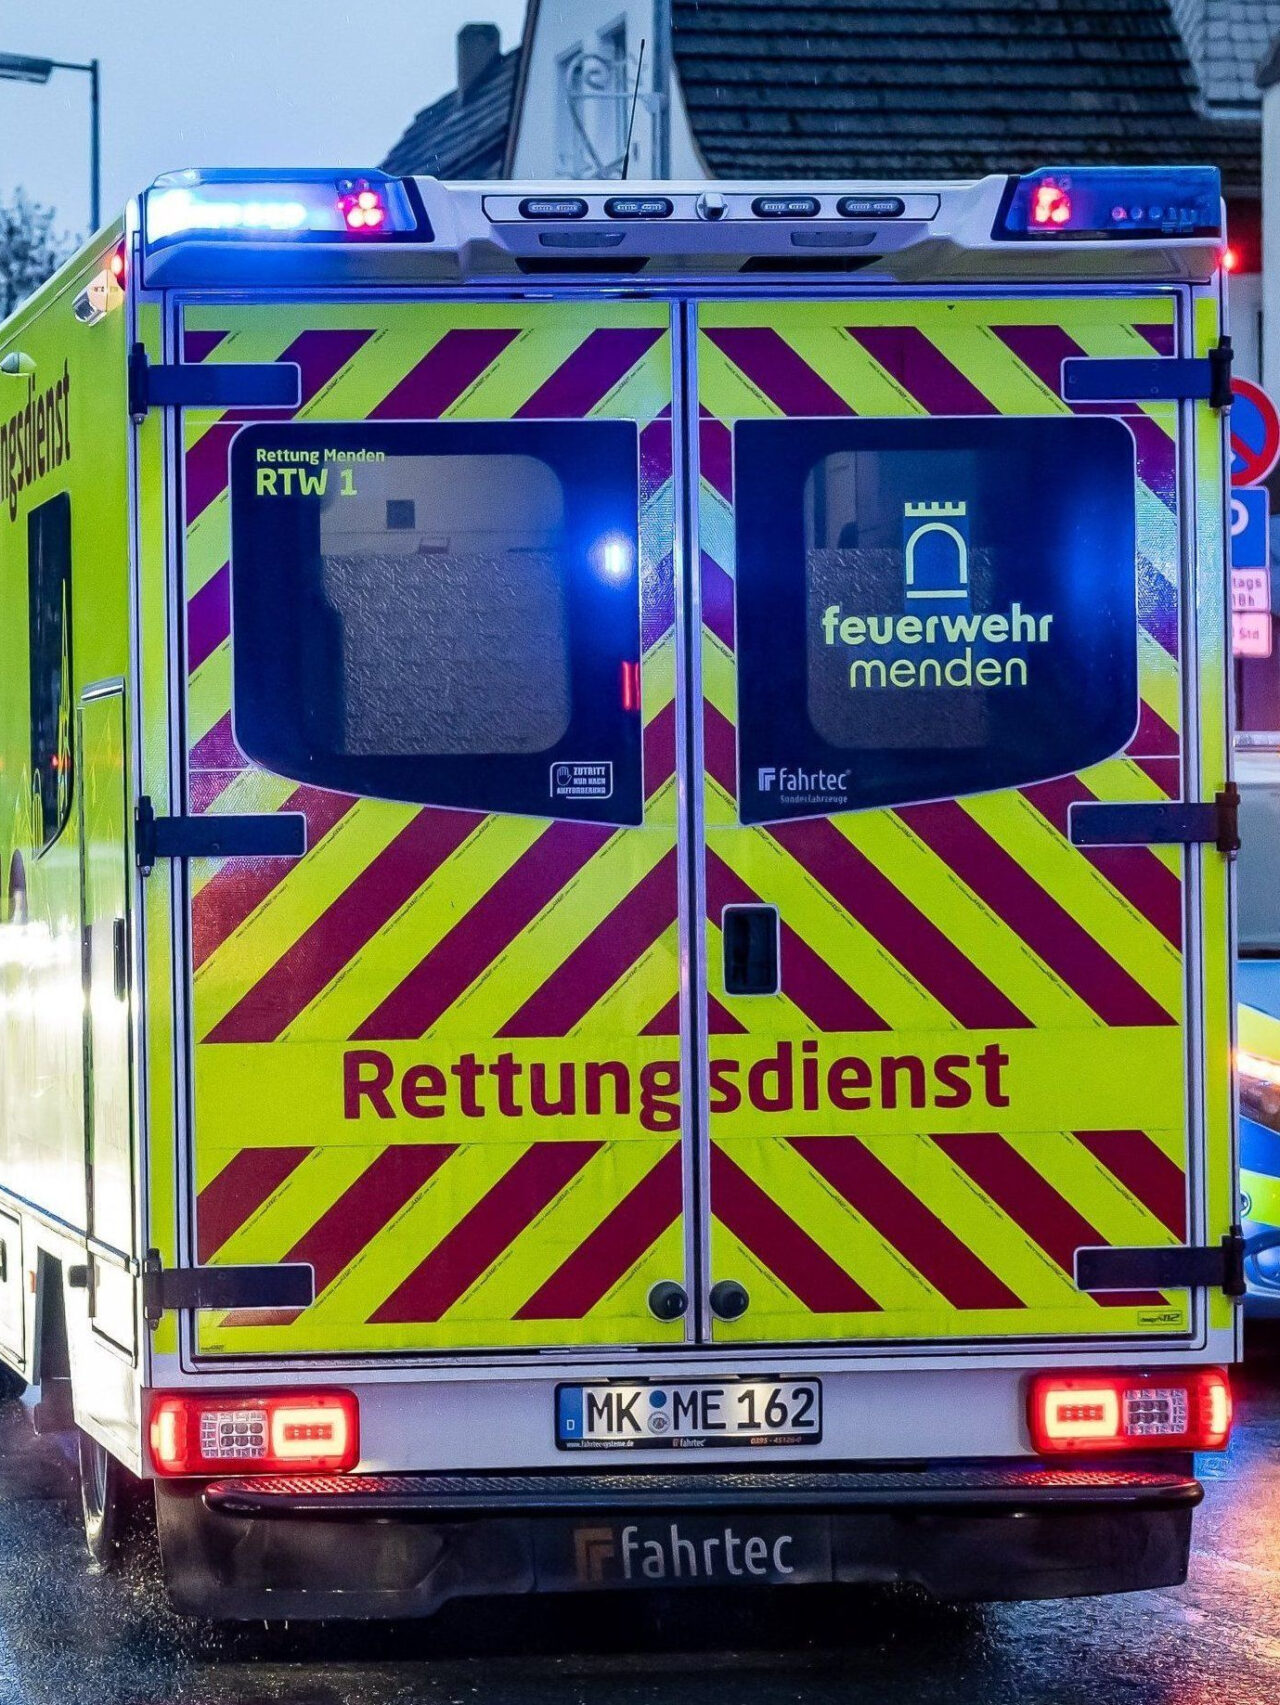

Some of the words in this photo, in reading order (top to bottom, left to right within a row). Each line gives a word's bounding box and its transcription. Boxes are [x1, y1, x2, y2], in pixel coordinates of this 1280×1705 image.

[256, 448, 320, 466] Rettung
[324, 448, 386, 463] Menden
[256, 467, 329, 496] RTW
[340, 468, 358, 496] 1
[1232, 577, 1262, 591] tags
[821, 602, 1054, 645] feuerwehr
[849, 646, 1028, 688] menden
[779, 767, 848, 791] fahrtec
[343, 1040, 1010, 1132] Rettungsdienst
[566, 1419, 575, 1431] D
[587, 1391, 642, 1433] MK
[673, 1389, 727, 1431] ME
[737, 1386, 815, 1430] 162
[621, 1523, 795, 1579] fahrtec
